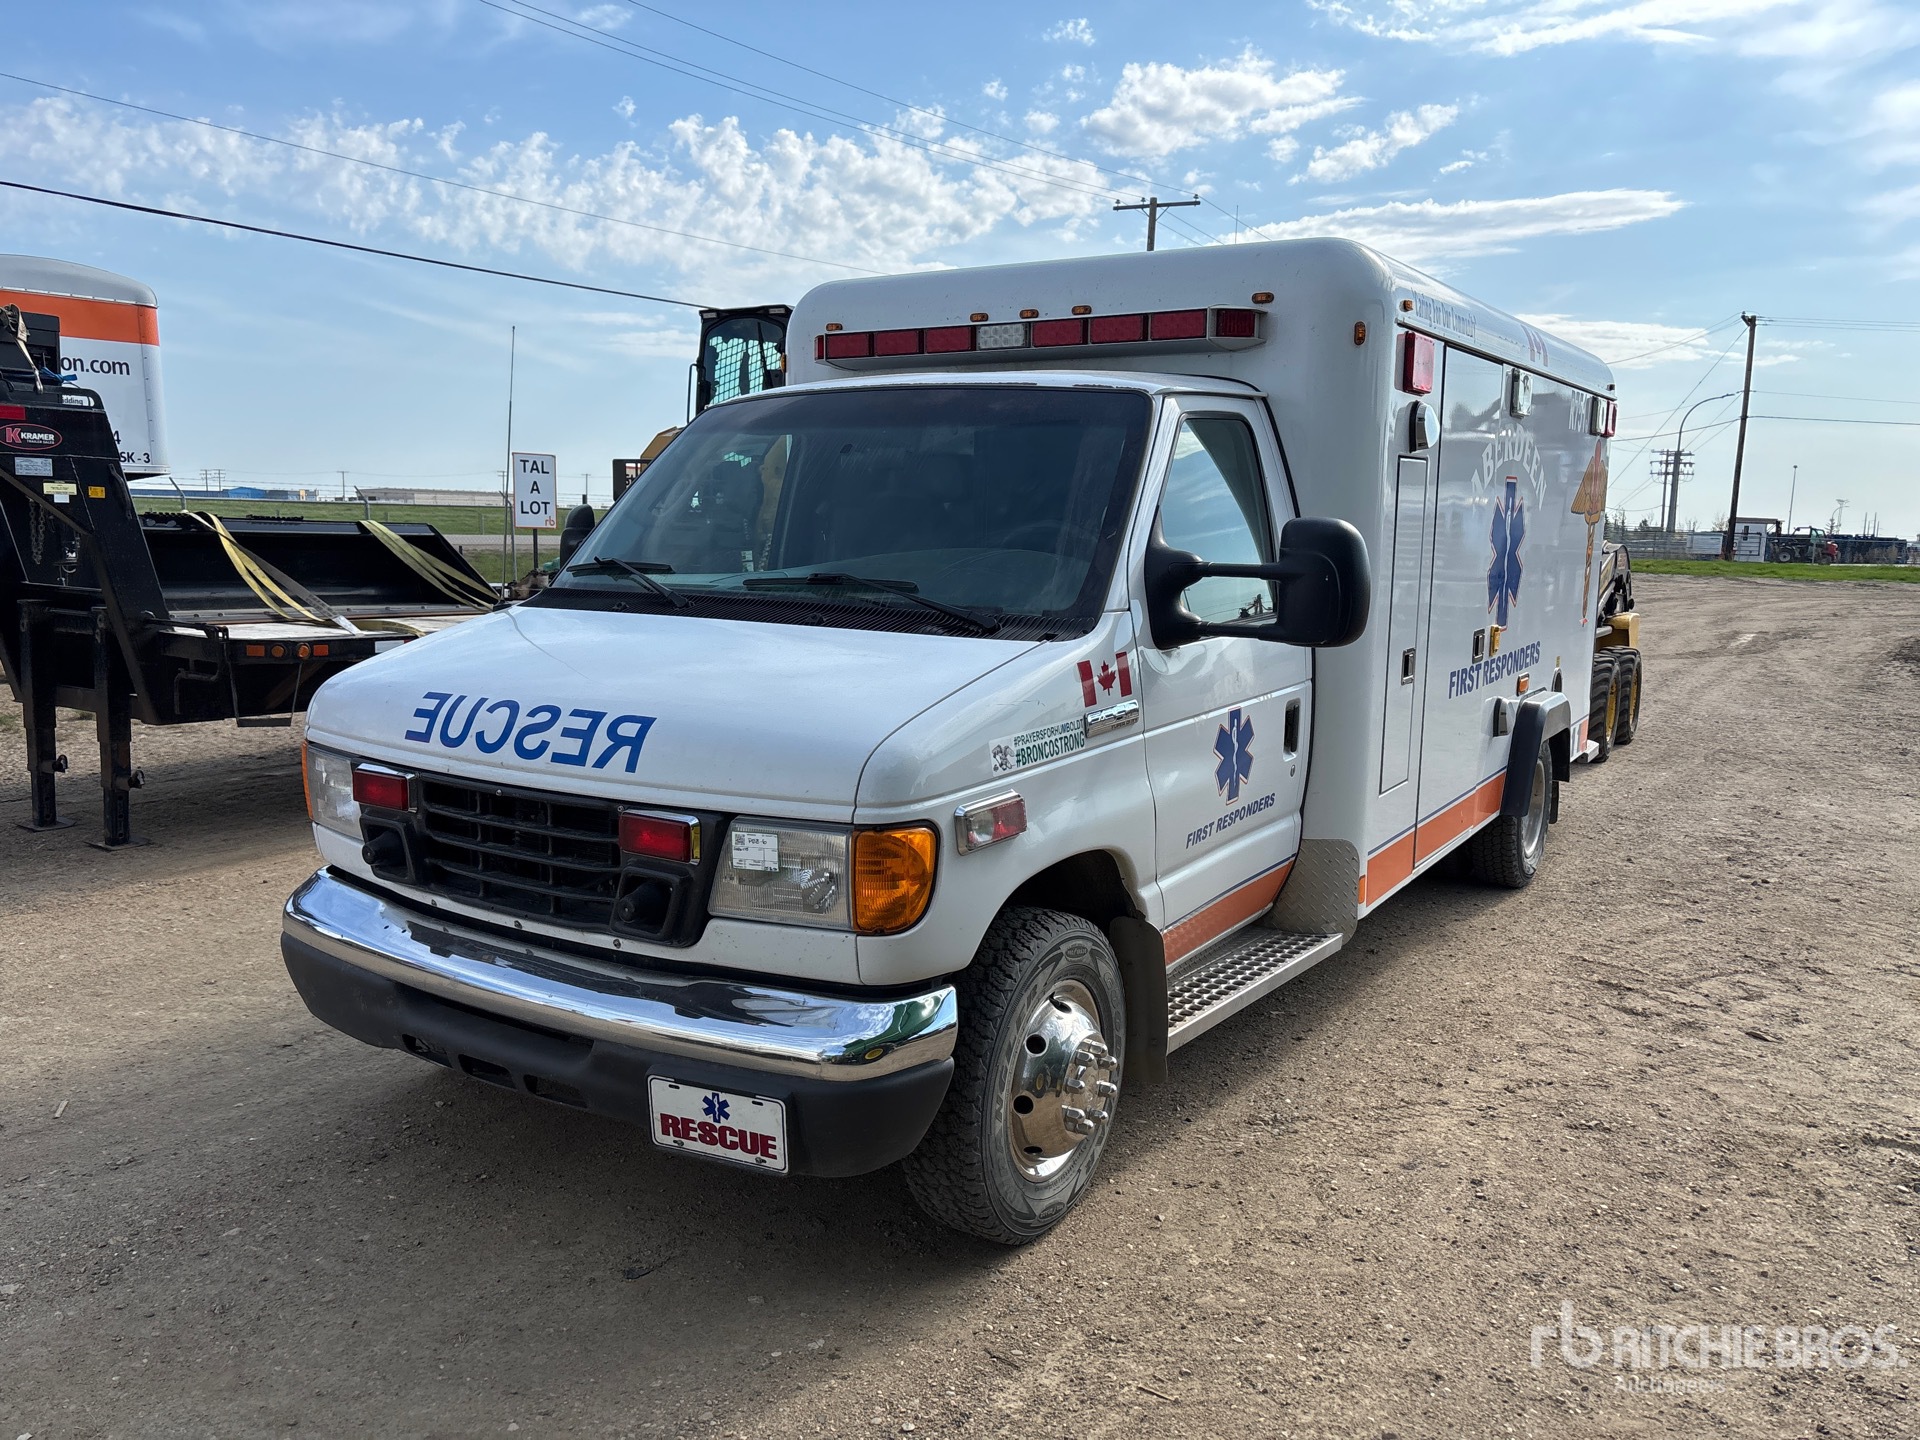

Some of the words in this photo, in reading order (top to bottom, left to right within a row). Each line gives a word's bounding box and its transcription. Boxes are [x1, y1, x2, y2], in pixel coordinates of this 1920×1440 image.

[20, 431, 55, 441] KRAMER
[143, 453, 151, 464] 3
[520, 459, 550, 474] TAL
[1470, 423, 1547, 516] ABERDEEN
[530, 480, 541, 494] A
[520, 501, 550, 515] LOT
[545, 516, 556, 527] rb
[1449, 662, 1482, 699] FIRST
[1482, 641, 1541, 687] RESPONDERS
[1013, 718, 1084, 748] #PRAYERSFORHUMBOLDT
[1015, 730, 1085, 768] #BRONCOSTRONG
[1186, 821, 1215, 849] FIRST
[1216, 793, 1275, 833] RESPONDERS
[660, 1112, 777, 1160] RESCUE
